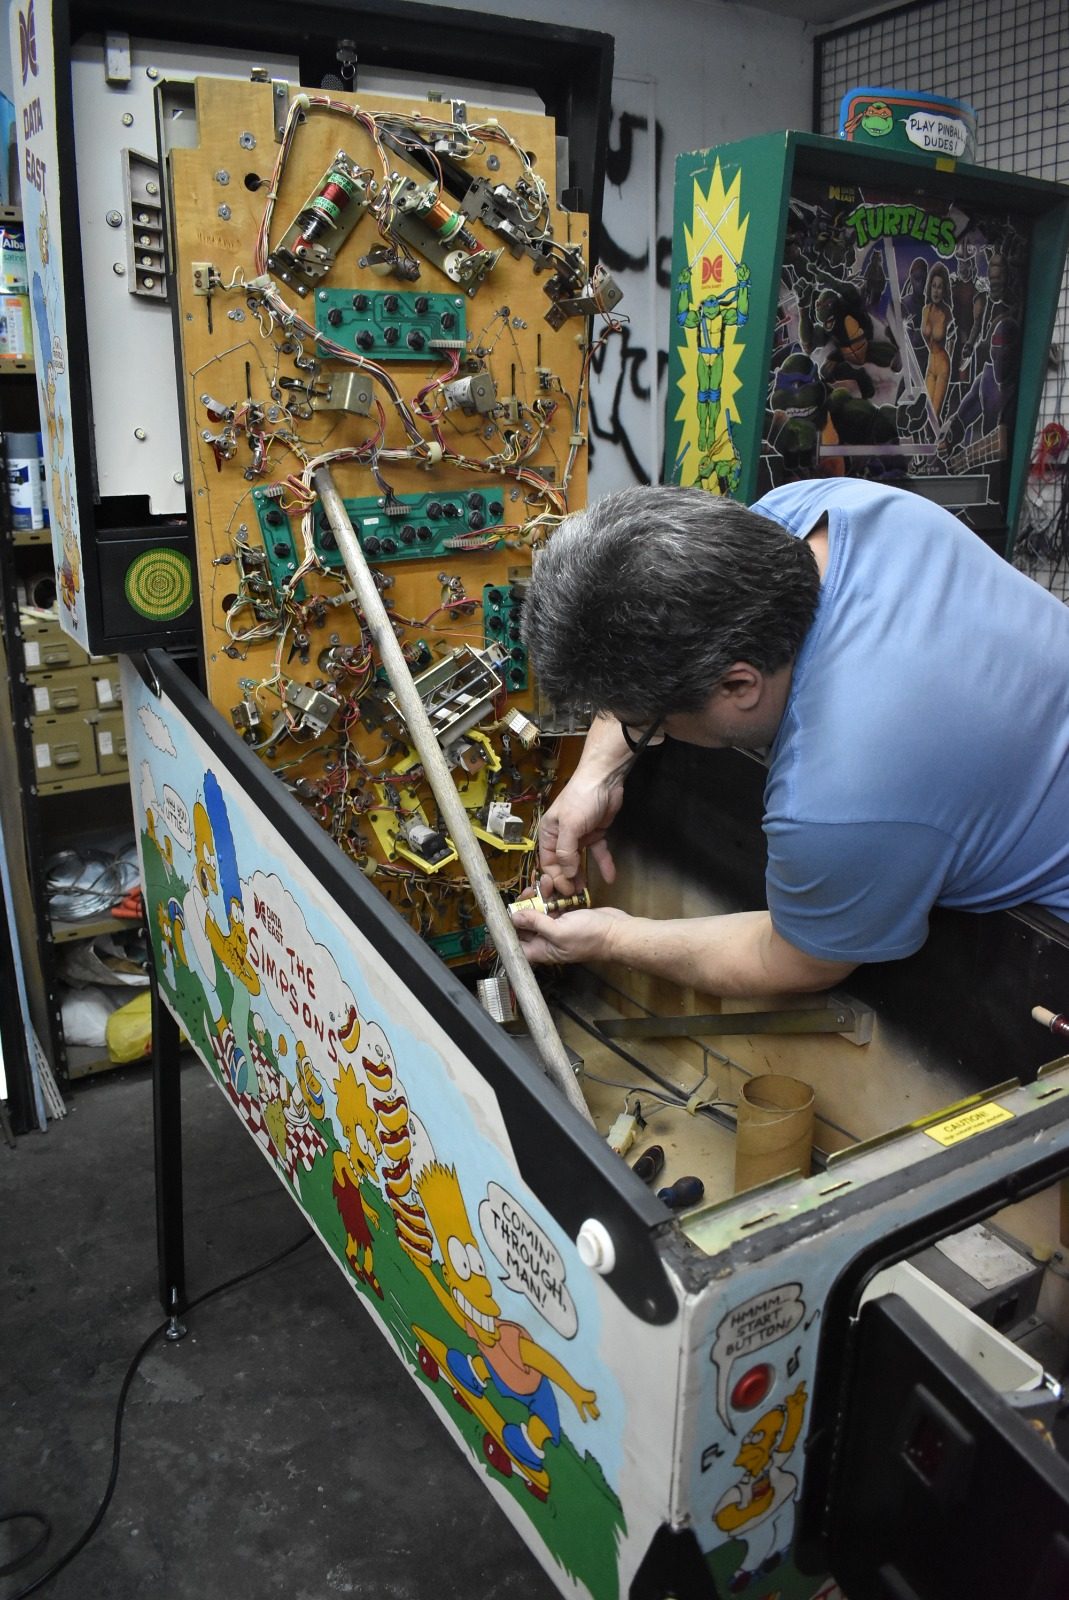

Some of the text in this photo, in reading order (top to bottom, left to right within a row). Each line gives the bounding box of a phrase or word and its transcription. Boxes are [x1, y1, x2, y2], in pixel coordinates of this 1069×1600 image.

[23, 97, 43, 141] DATA
[909, 118, 935, 132] PLAY
[924, 134, 958, 154] DUDES!
[25, 147, 47, 197] EAST
[845, 204, 957, 257] TURTLES
[266, 905, 282, 932] DATA
[267, 924, 284, 947] EAST
[249, 926, 338, 1064] SIMPSONS
[286, 947, 316, 1000] THE
[501, 1202, 556, 1266] COMIN'
[491, 1209, 567, 1313] THROUGH,
[506, 1250, 549, 1309] MAN!
[736, 1306, 783, 1338] START
